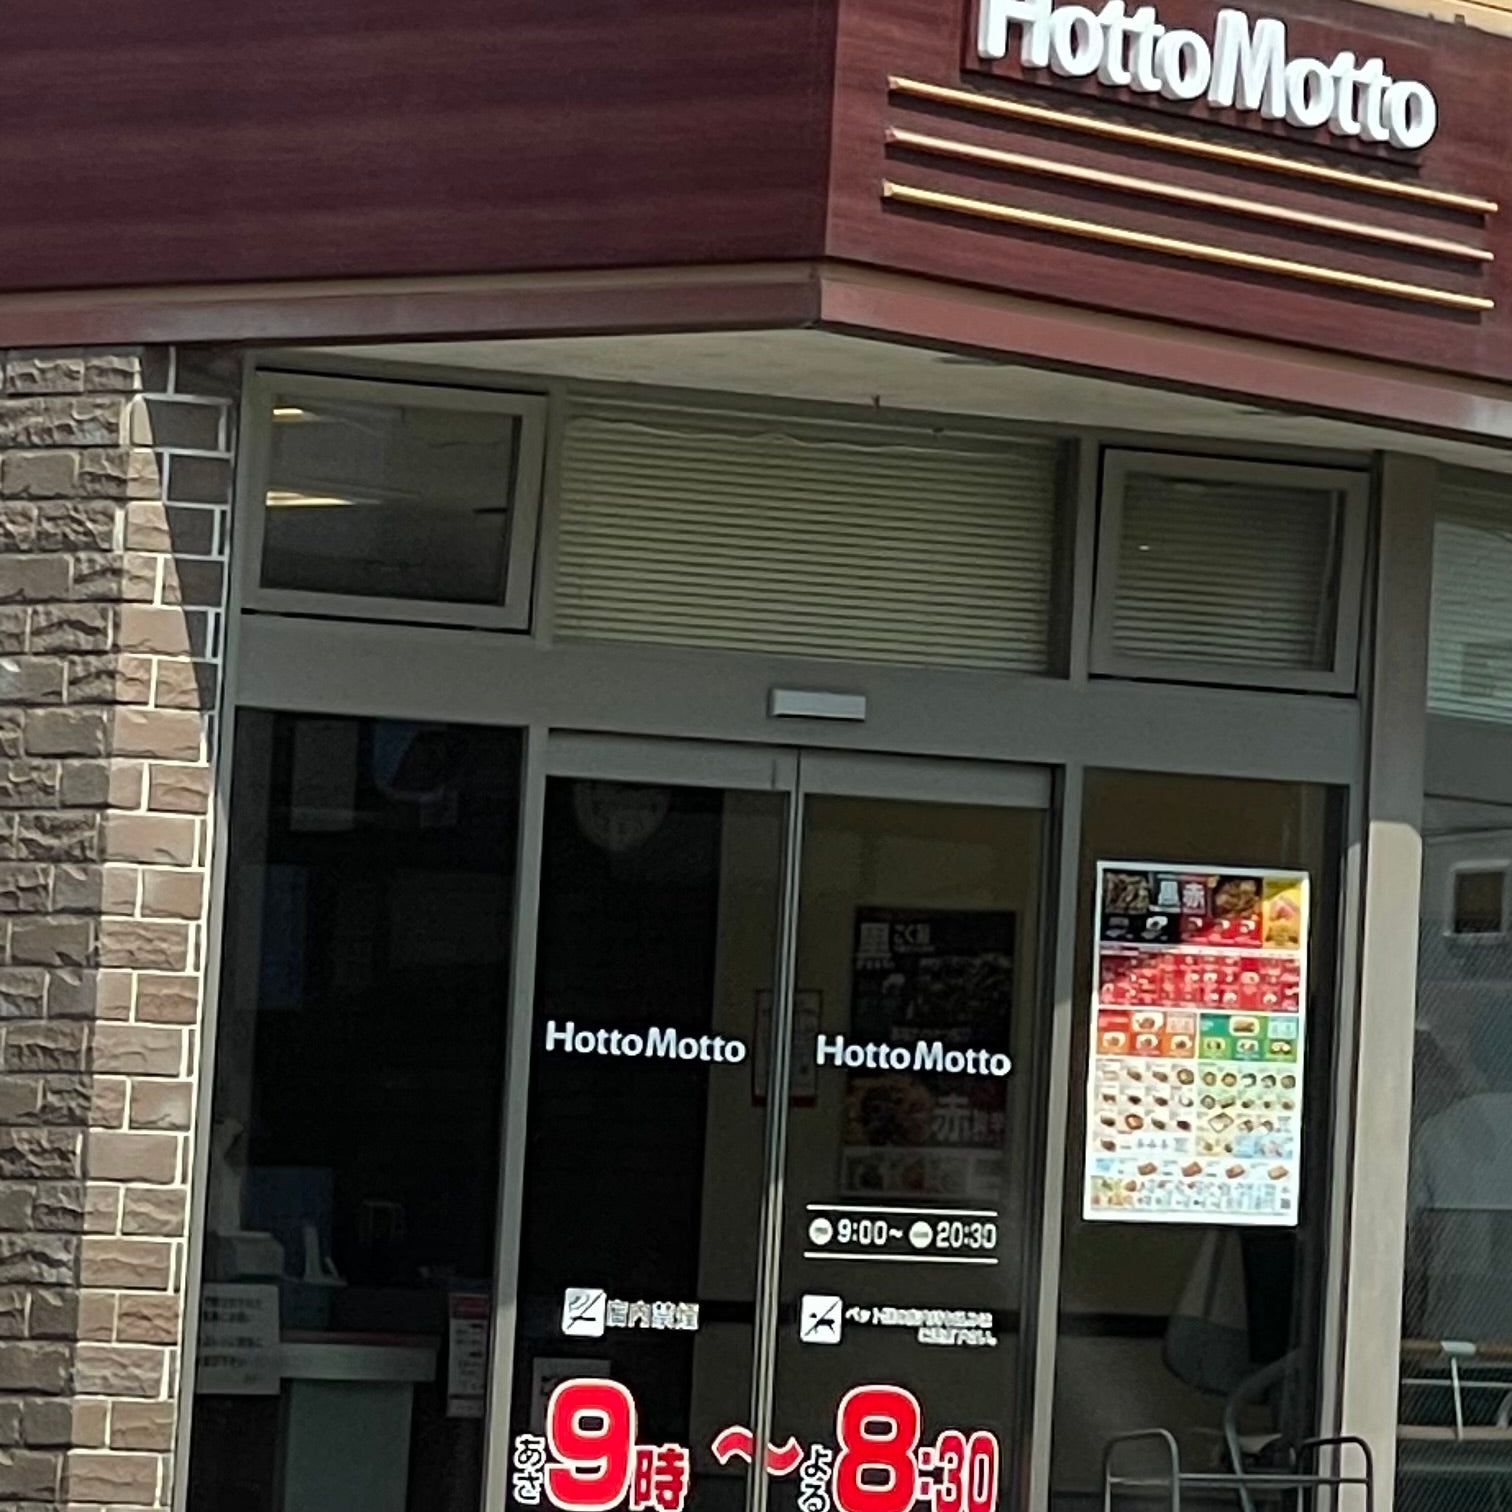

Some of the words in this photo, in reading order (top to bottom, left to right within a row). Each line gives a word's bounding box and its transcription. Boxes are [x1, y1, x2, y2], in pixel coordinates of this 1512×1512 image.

[545, 1019, 747, 1064] HottoMotto
[815, 1034, 1013, 1077] HottoMotto
[936, 1221, 997, 1248] 20:30
[513, 1434, 546, 1505] あさ
[797, 1444, 833, 1512] よる
